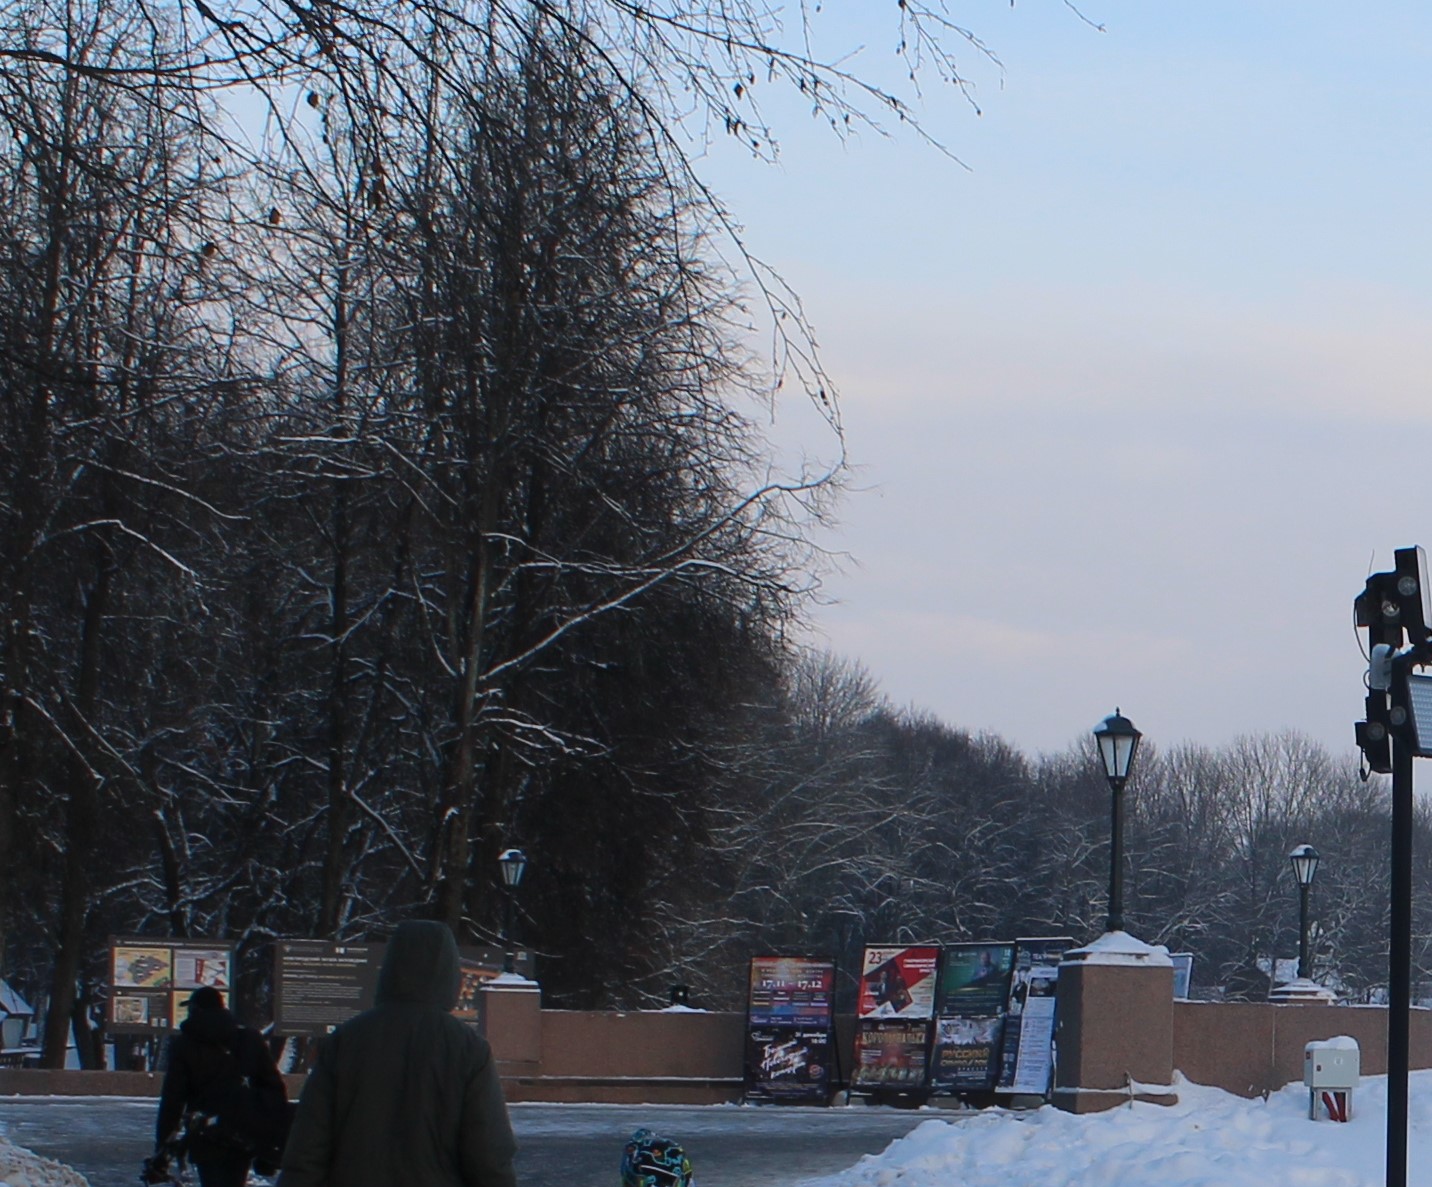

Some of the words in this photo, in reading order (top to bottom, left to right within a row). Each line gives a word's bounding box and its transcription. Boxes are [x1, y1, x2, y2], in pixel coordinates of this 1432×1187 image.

[868, 951, 882, 964] 23
[762, 980, 785, 989] 17.11
[797, 980, 823, 990] 17.12
